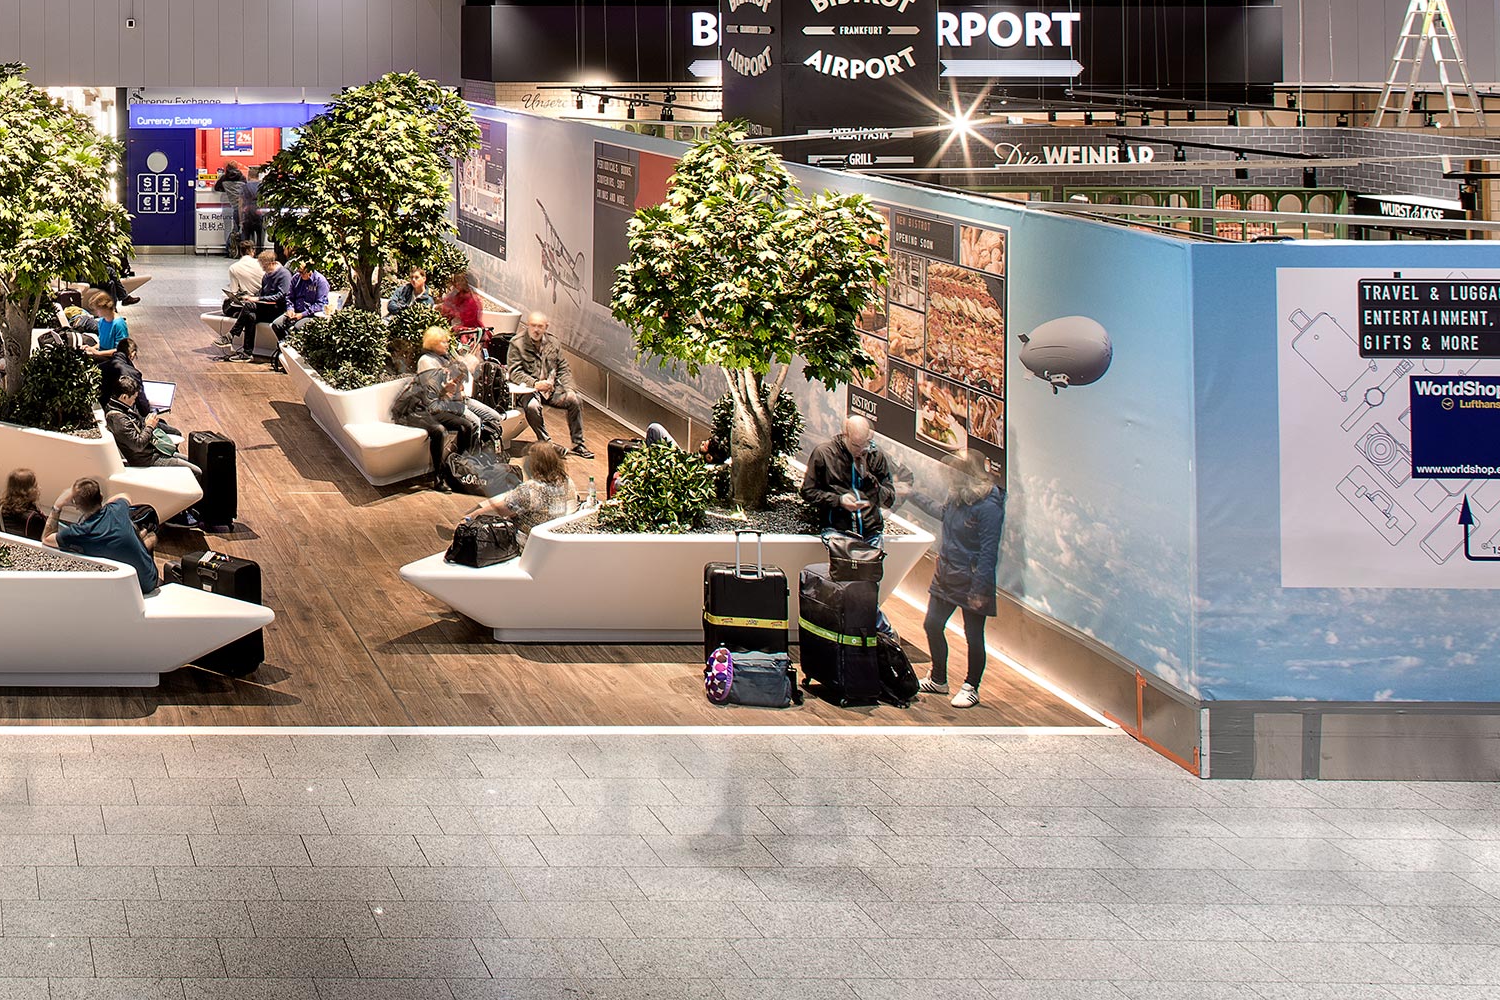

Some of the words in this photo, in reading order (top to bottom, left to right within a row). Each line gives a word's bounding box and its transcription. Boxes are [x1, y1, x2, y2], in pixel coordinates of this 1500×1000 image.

[840, 26, 883, 35] FRANKFURT
[938, 12, 1081, 47] RPORT
[727, 45, 773, 77] AIRPORT
[803, 46, 917, 80] AIRPORT
[137, 117, 173, 127] Currency
[175, 116, 213, 127] Exchange
[849, 153, 874, 166] GRILL
[994, 143, 1042, 165] Die
[1380, 202, 1412, 218] WURST
[896, 232, 918, 247] OPENING
[920, 238, 934, 250] SOON
[1363, 285, 1420, 301] TRAVEL
[1430, 287, 1440, 301] &
[1450, 286, 1500, 301] LUGGA
[1363, 335, 1412, 351] GIFTS
[1422, 337, 1432, 351] &
[1441, 336, 1479, 351] MORE
[852, 393, 878, 415] BISTROT
[1460, 400, 1500, 409] Lufthans
[1417, 465, 1500, 476] www.worldshop.e
